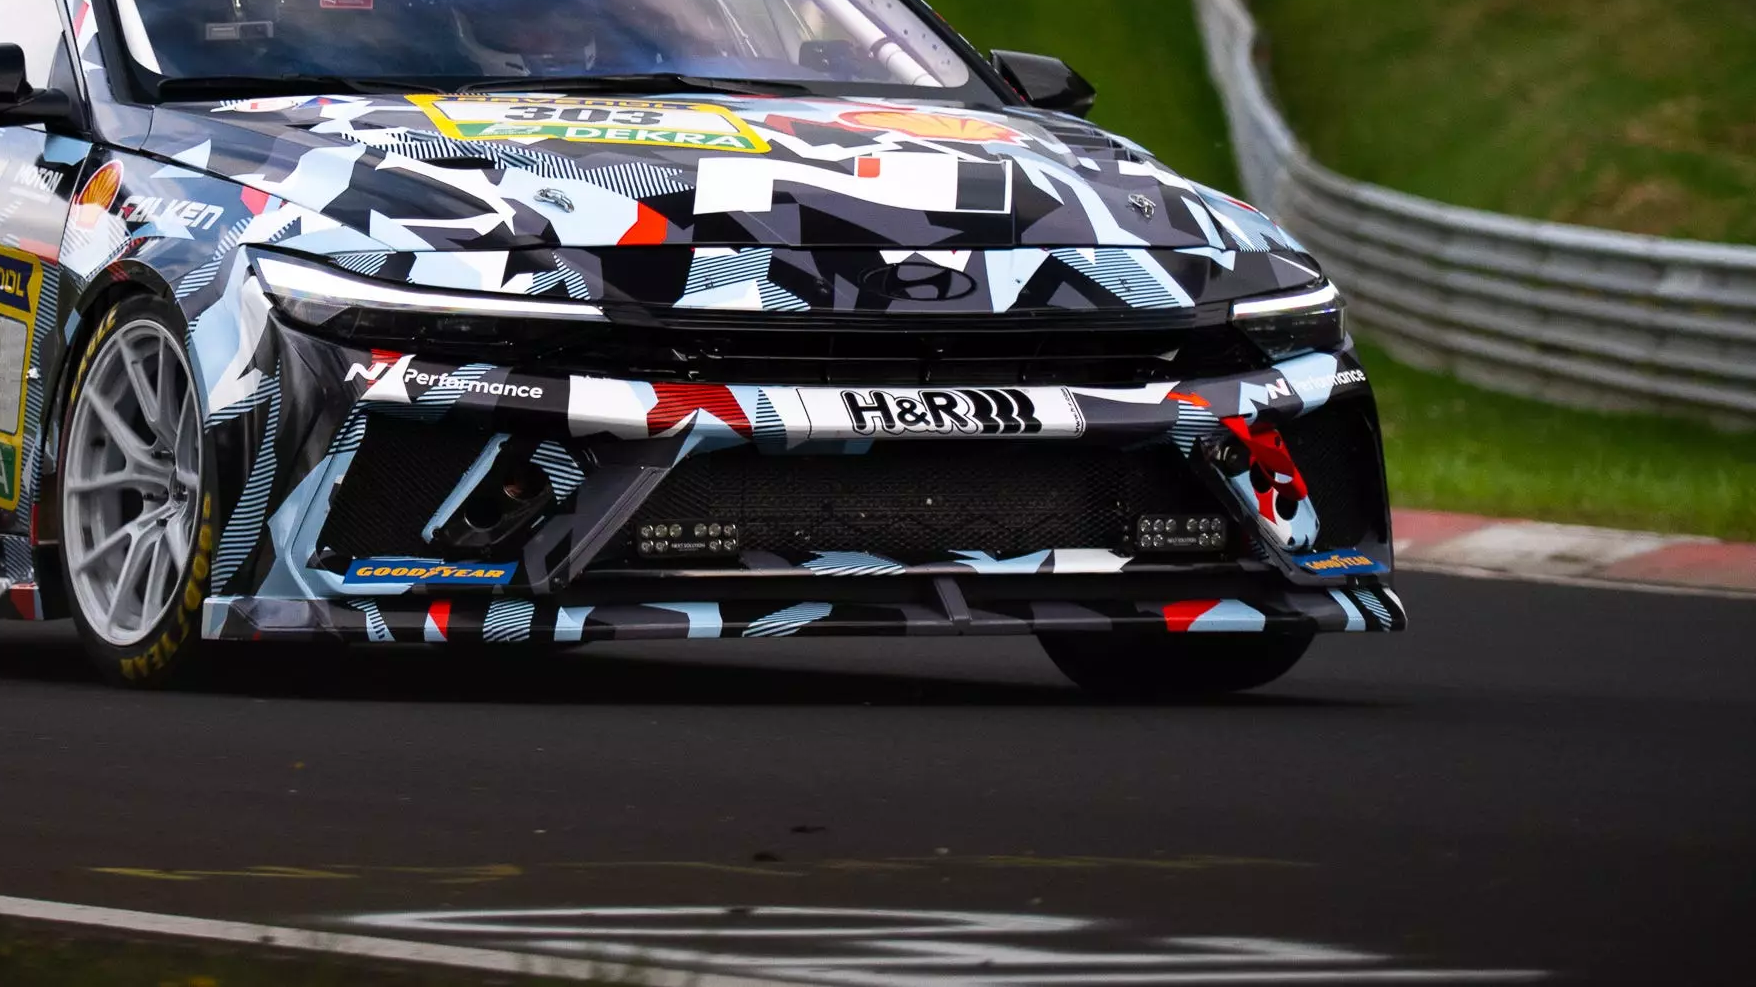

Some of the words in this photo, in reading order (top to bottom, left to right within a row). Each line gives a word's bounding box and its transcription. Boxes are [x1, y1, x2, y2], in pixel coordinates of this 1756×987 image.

[504, 105, 664, 126] 303
[564, 126, 747, 150] DEKRA
[13, 163, 64, 194] MOTON
[116, 195, 224, 230] FALKEN
[404, 368, 544, 400] Performance
[356, 566, 506, 579] GOODYEAR
